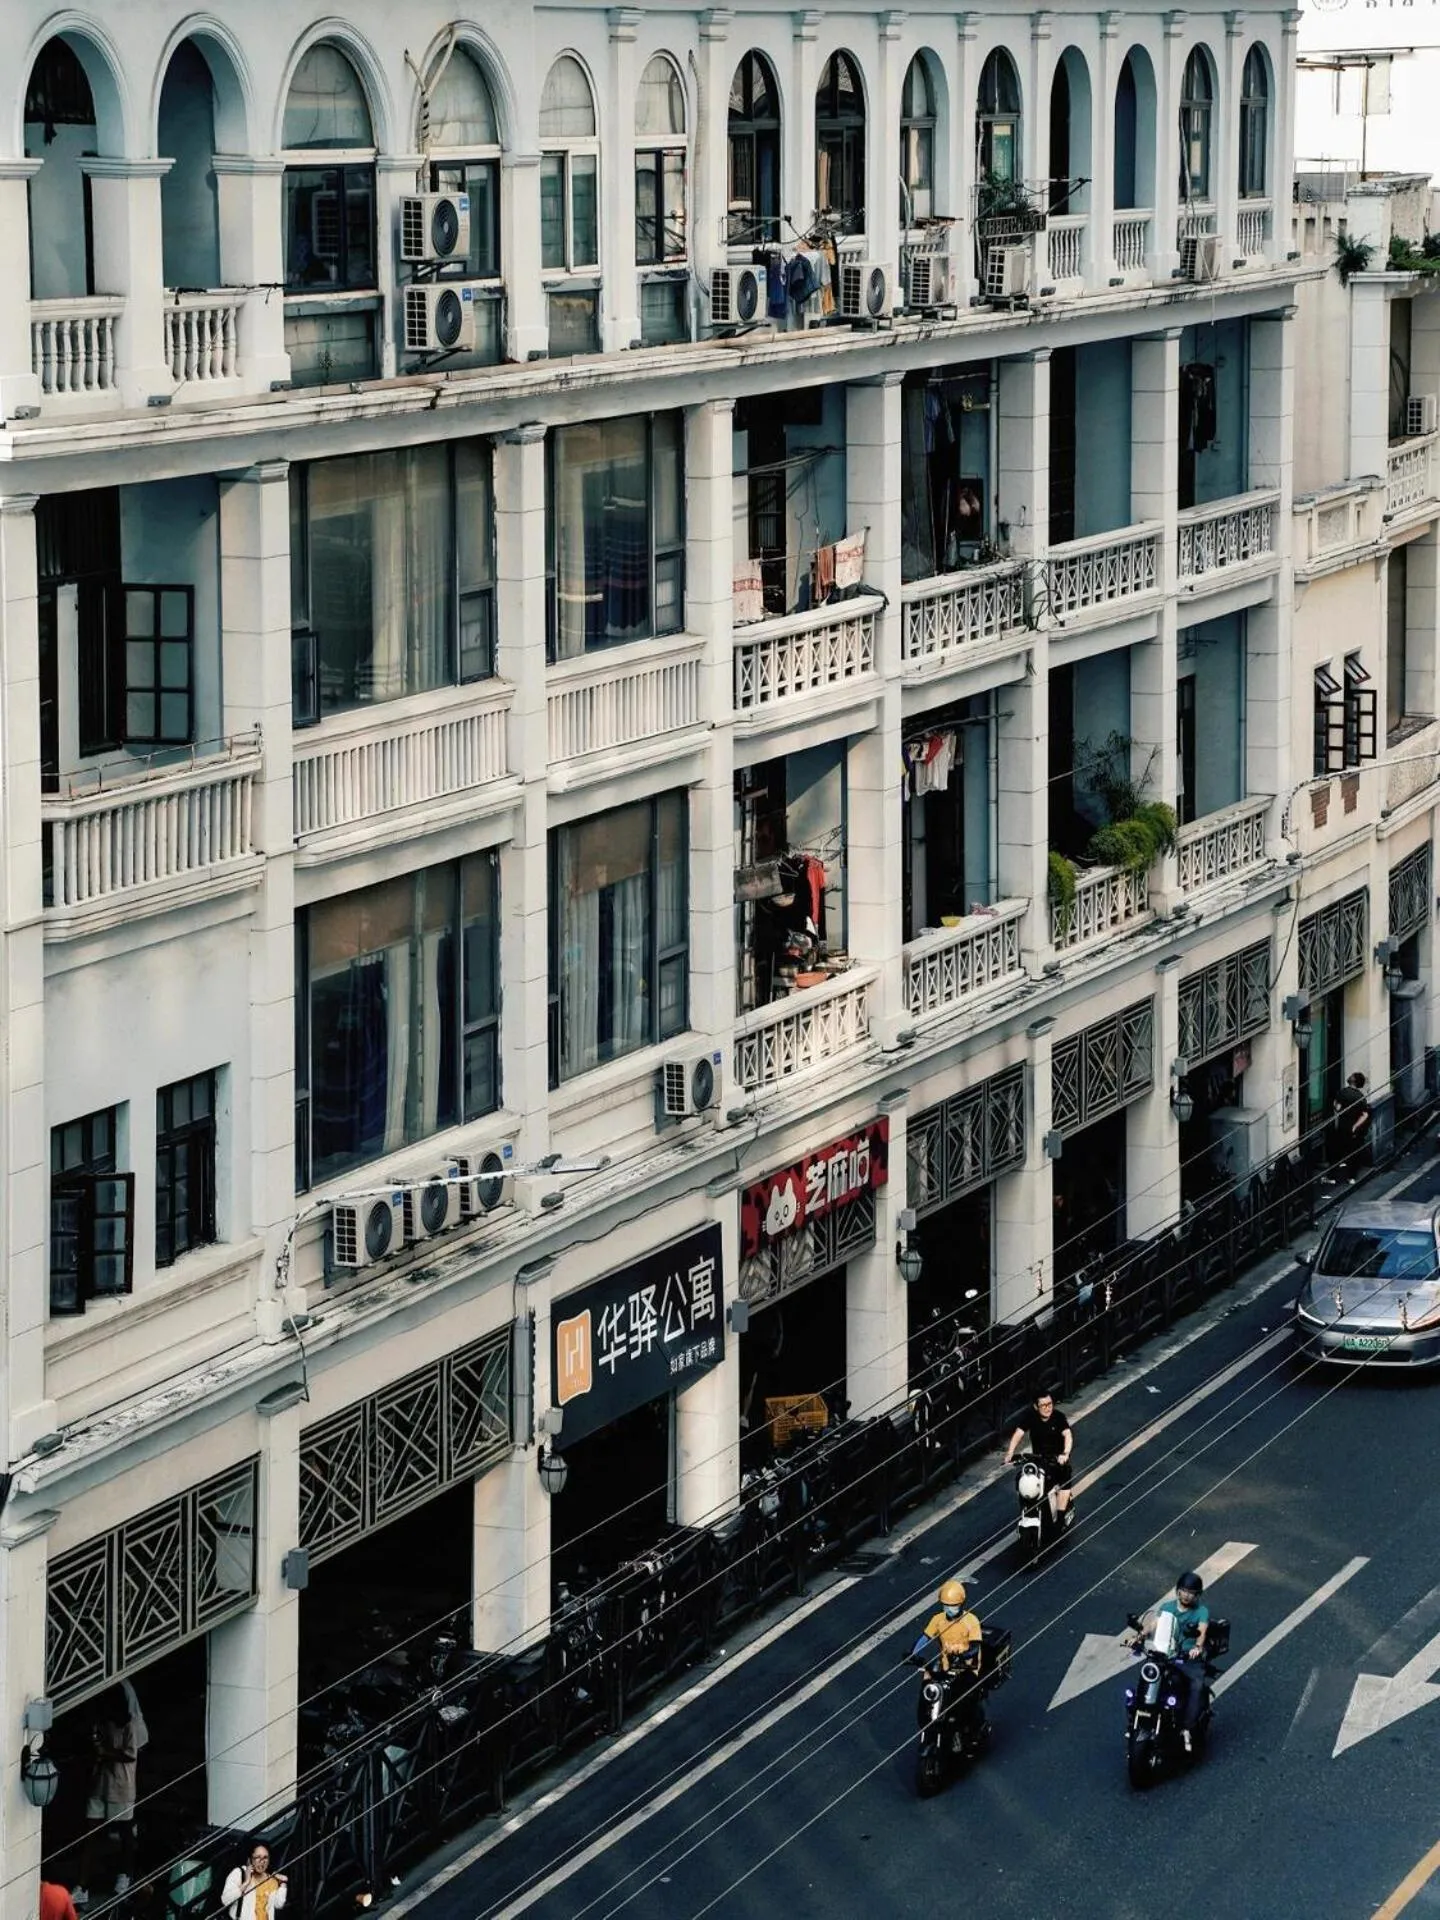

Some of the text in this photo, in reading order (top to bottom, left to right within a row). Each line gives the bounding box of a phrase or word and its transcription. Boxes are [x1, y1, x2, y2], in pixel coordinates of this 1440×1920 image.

[804, 1136, 870, 1216] 芝麻响
[597, 1255, 716, 1375] 华驿公寓
